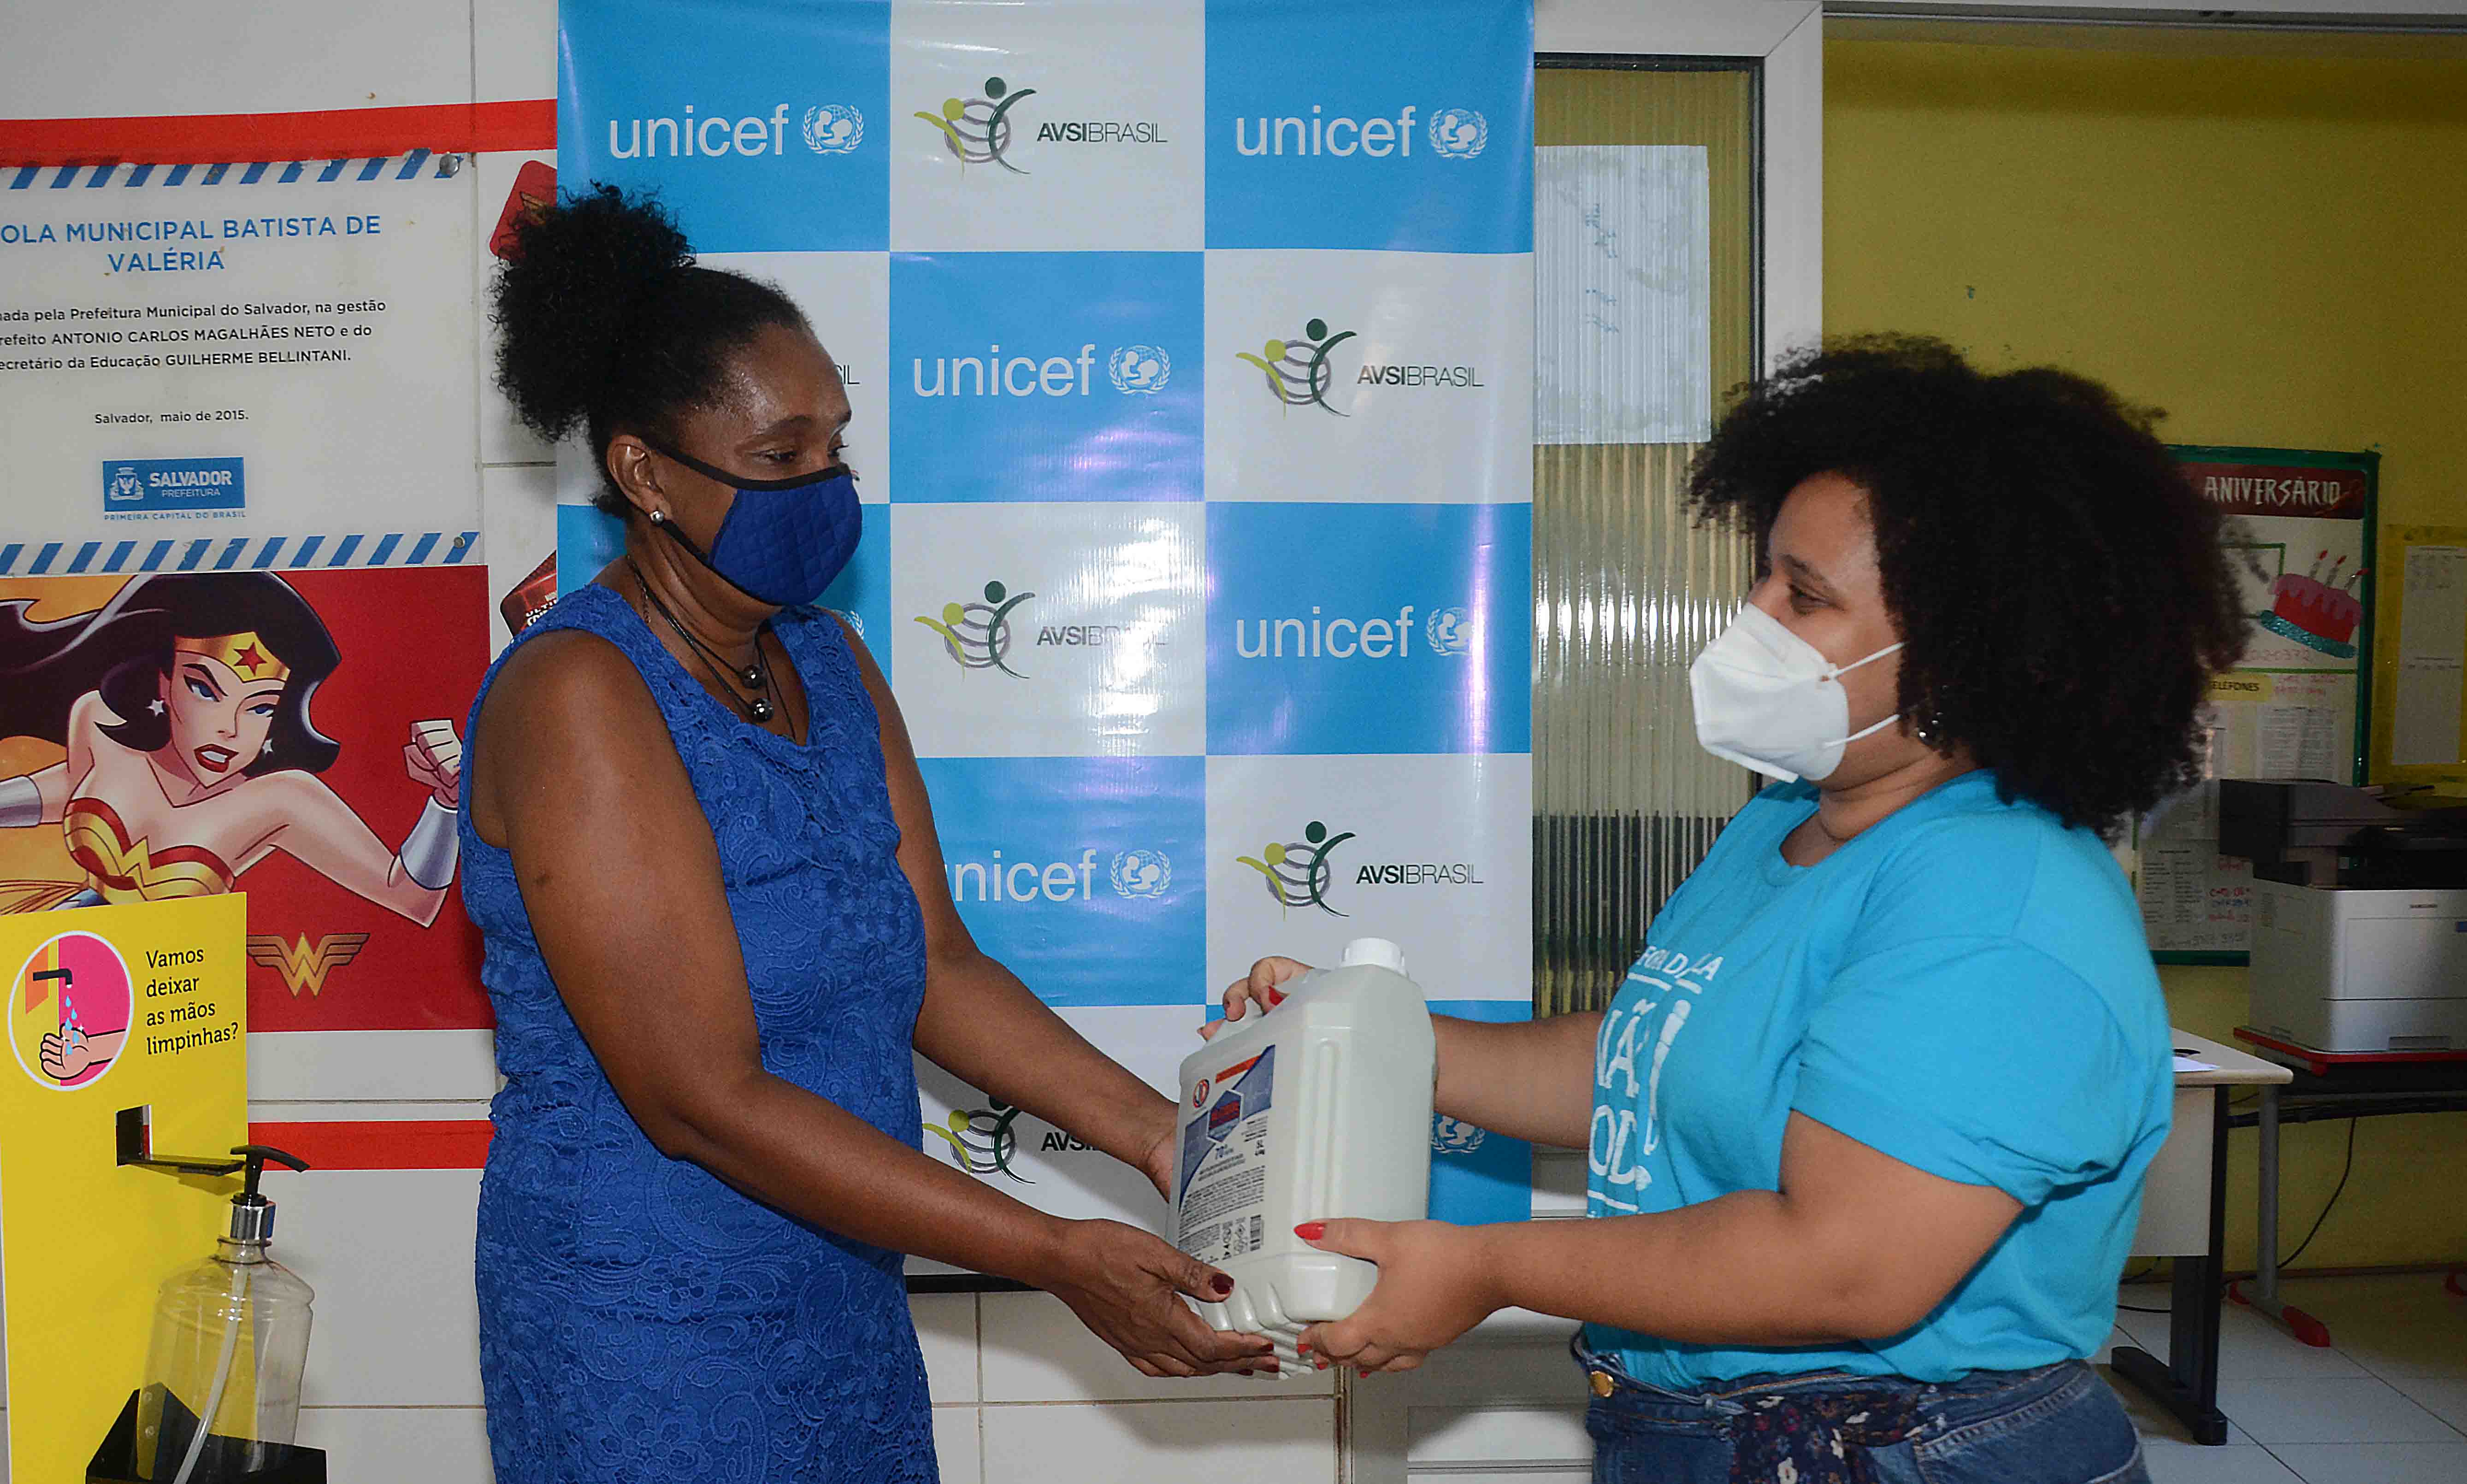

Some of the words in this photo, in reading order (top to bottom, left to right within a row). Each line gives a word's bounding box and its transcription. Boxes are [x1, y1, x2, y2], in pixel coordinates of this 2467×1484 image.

[609, 103, 790, 159] unicef
[1037, 121, 1168, 143] AVSIBRASIL
[1236, 105, 1416, 157] unicef
[0, 224, 57, 243] OLA
[66, 220, 214, 242] MUNICIPAL
[224, 217, 336, 238] BATISTA
[347, 215, 381, 235] DE
[107, 247, 224, 272] VALÉRIA
[0, 310, 29, 322] ada
[35, 309, 65, 323] pela
[71, 307, 142, 320] Prefeitura
[147, 305, 215, 318] Municipal
[220, 304, 239, 316] do
[244, 302, 310, 315] Salvador,
[315, 303, 331, 312] na
[337, 300, 386, 314] gestão
[0, 333, 46, 345] refeito
[52, 332, 122, 345] ANTONIO
[129, 330, 189, 342] CARLOS
[195, 325, 288, 341] MAGALHÃES
[295, 325, 335, 338] NETO
[340, 328, 348, 337] e
[354, 324, 372, 336] do
[0, 357, 63, 370] ecretário
[68, 356, 85, 368] da
[91, 354, 160, 369] Educação
[166, 352, 254, 366] GUILHERME
[259, 349, 351, 364] BELLINTANI.
[914, 343, 1095, 397] unicef
[1357, 366, 1484, 387] AVSIBRASIL
[95, 412, 153, 424] Salvador,
[161, 411, 191, 422] maio
[196, 411, 212, 421] de
[215, 410, 249, 421] 2015.
[149, 471, 233, 487] SALVADOR
[162, 488, 221, 498] PREFEITURA
[2202, 475, 2342, 507] ANIVERSÁRIO
[1237, 606, 1414, 659] unicef
[2211, 680, 2260, 692] ELEFONES
[944, 848, 1098, 902] nicef
[1355, 864, 1483, 885] AVSIBRASIL
[146, 949, 204, 969] Vamos
[146, 976, 200, 997] deixar
[147, 1011, 165, 1026] as
[170, 1001, 216, 1023] mãos
[147, 1022, 238, 1055] limpinhas?
